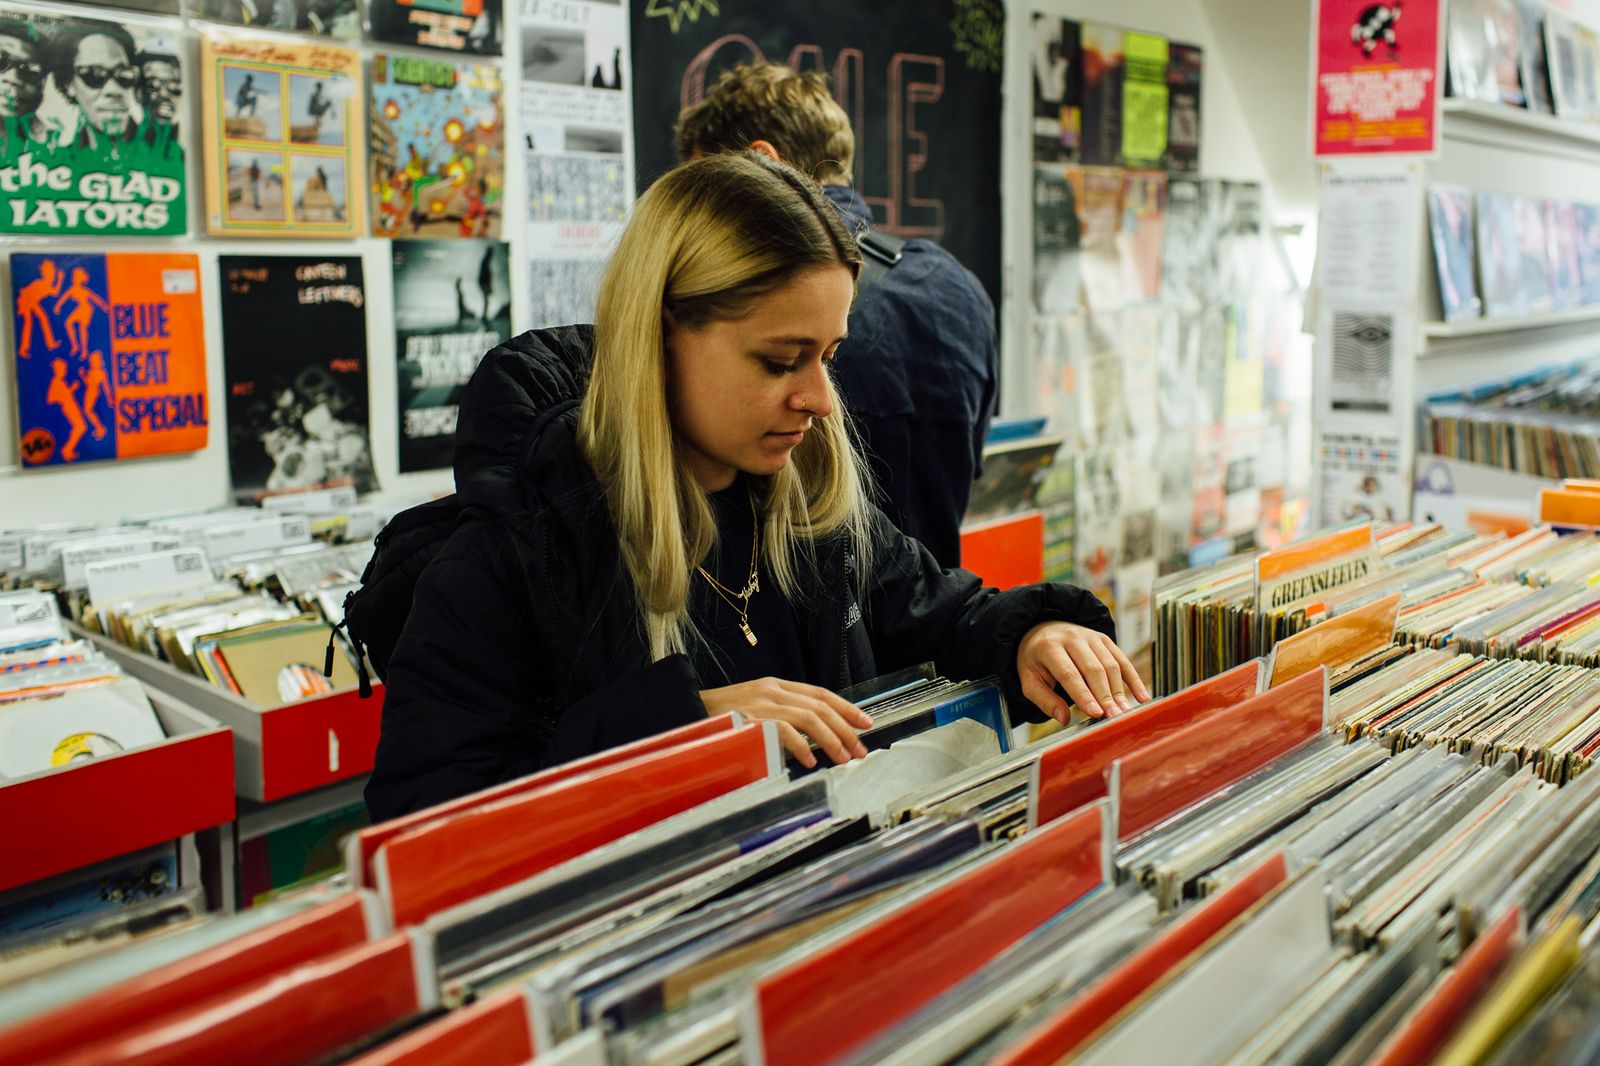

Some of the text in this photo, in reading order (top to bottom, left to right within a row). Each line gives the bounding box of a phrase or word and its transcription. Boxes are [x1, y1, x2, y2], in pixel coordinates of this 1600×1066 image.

[0, 152, 181, 202] the GLAD
[8, 198, 170, 230] IATORS
[113, 303, 170, 339] BLUE
[116, 349, 170, 386] BEAT
[119, 391, 209, 433] SPECIAL
